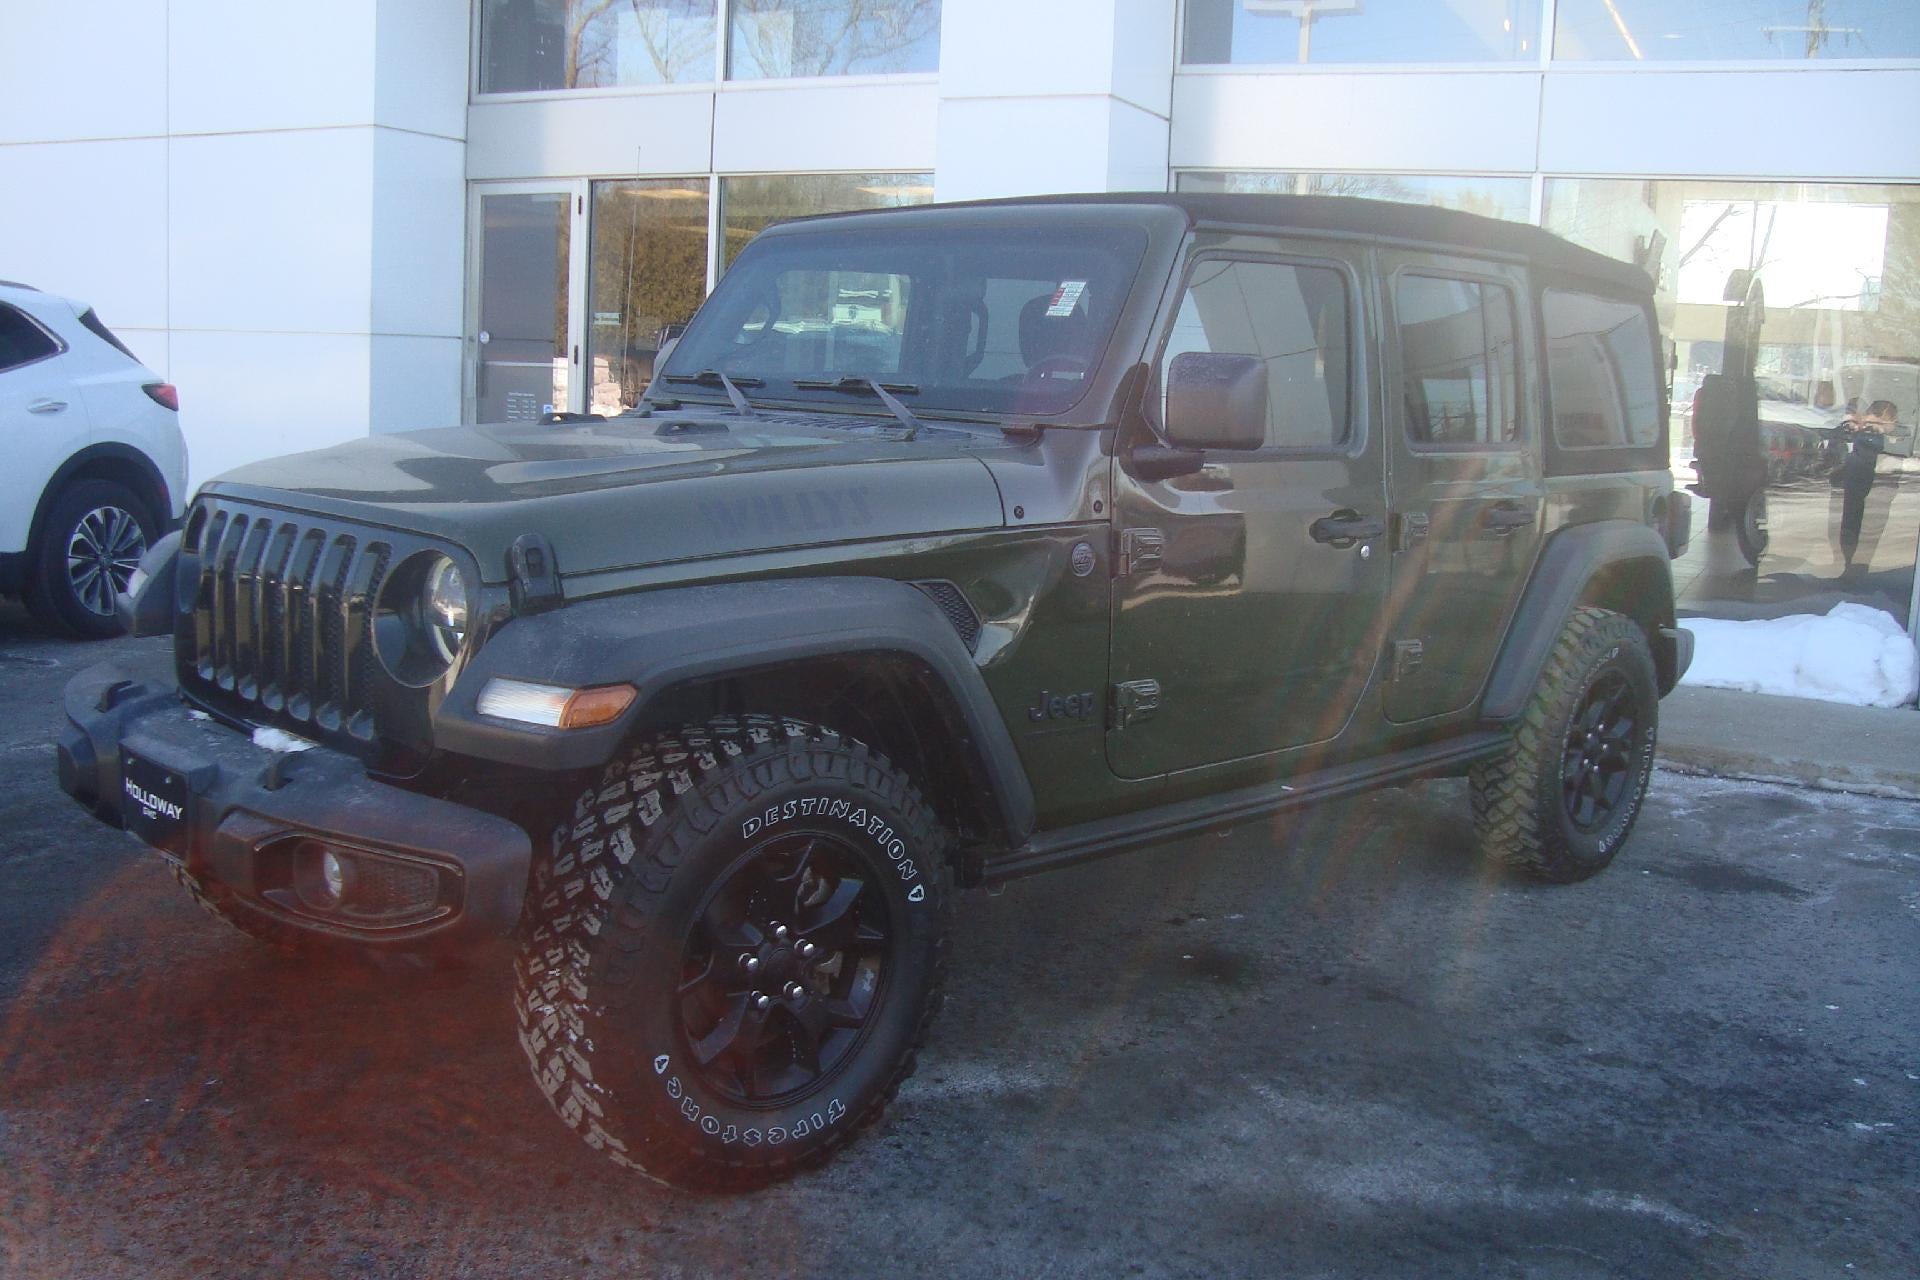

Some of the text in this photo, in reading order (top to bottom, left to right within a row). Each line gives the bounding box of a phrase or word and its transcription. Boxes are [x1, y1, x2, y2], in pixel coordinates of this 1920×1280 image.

[1028, 688, 1095, 722] Jeep
[125, 776, 184, 821] HOLLOWAY
[742, 797, 918, 881] DESTINATION
[666, 1077, 847, 1146] Firestone
